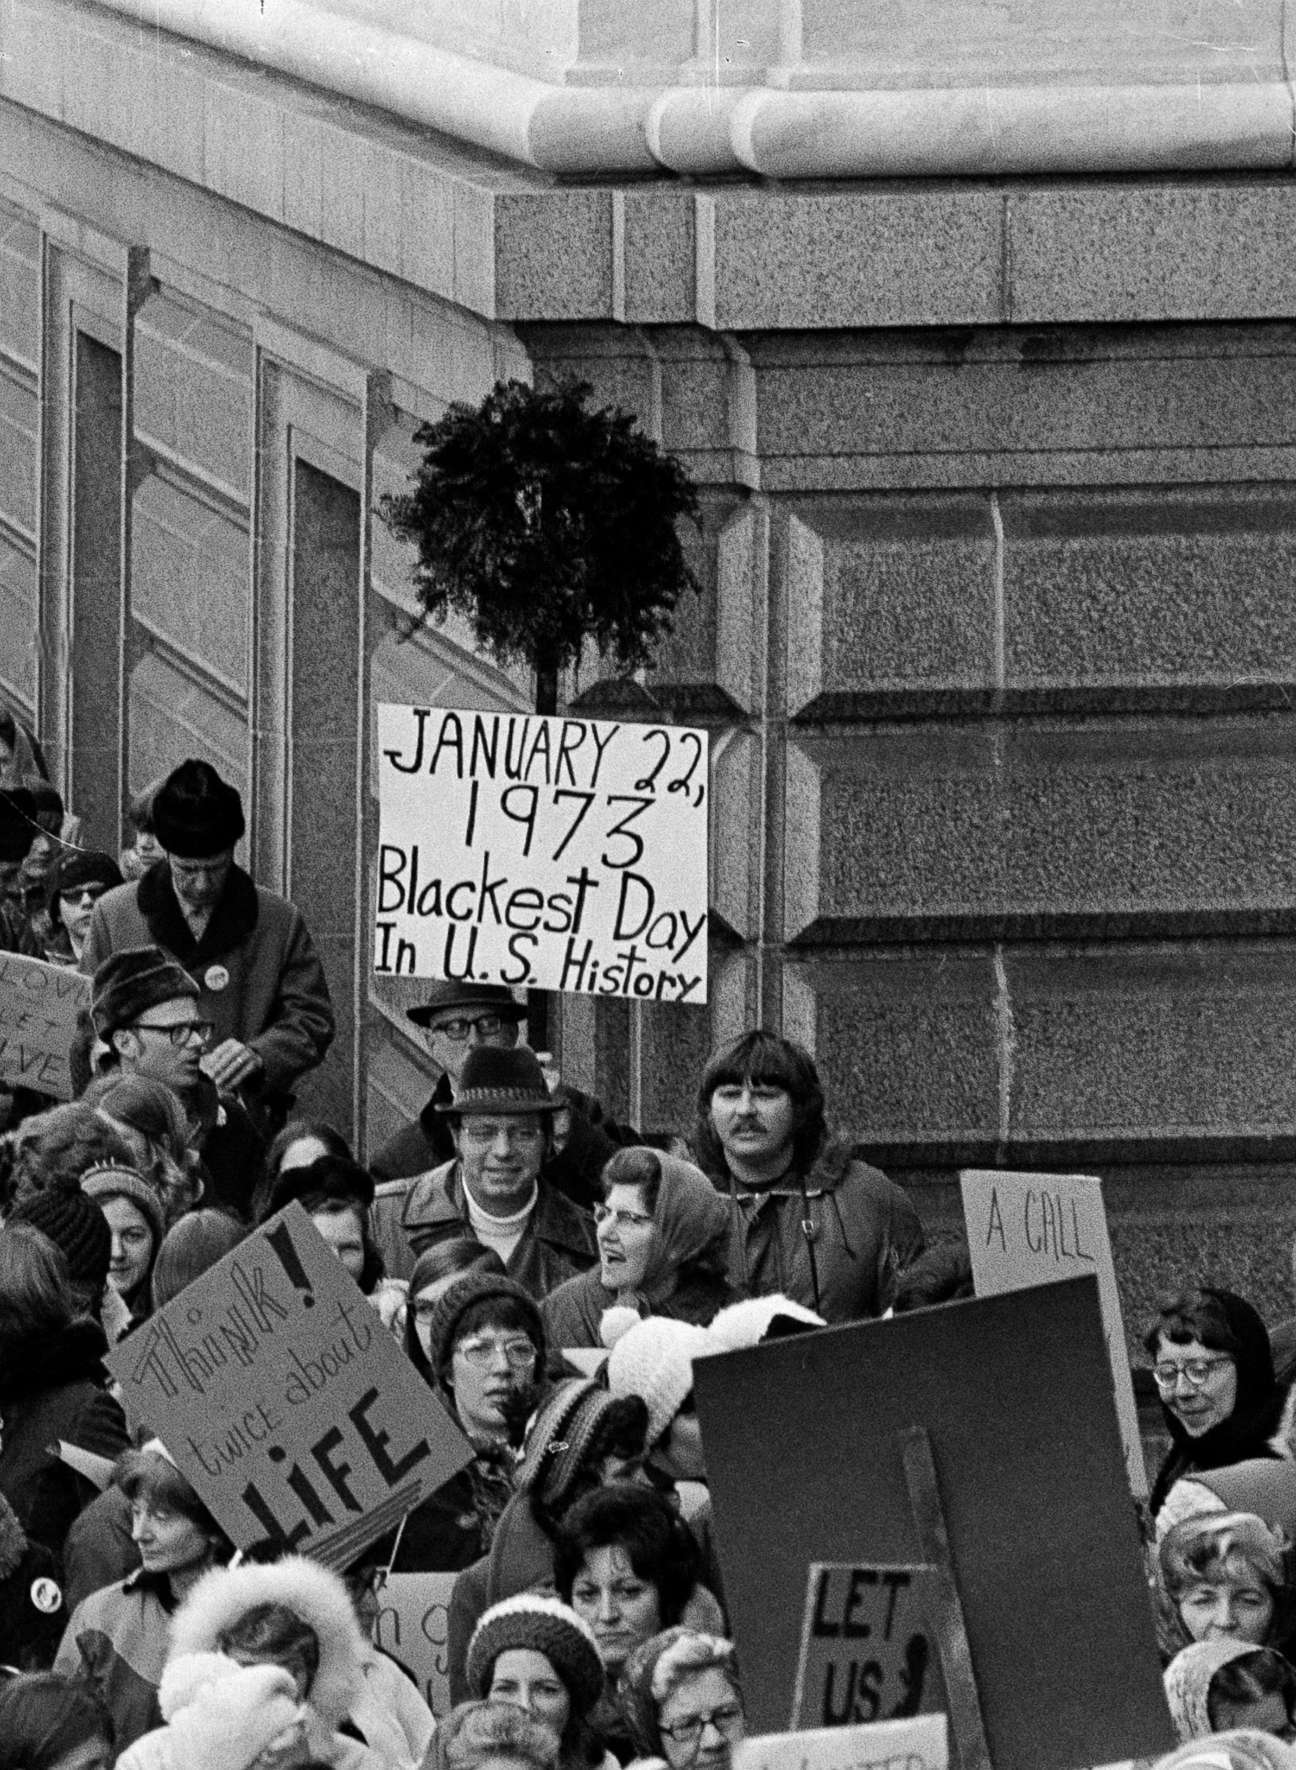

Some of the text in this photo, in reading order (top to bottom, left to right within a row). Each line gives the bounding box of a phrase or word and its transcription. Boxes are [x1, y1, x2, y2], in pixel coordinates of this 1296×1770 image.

[383, 708, 705, 808] JANUARY 22,
[465, 780, 656, 869] 1973
[377, 844, 707, 964] Blackest Day
[375, 923, 416, 974] In
[559, 938, 702, 1000] History
[986, 1186, 1096, 1263] A CALL
[284, 1301, 373, 1406] about
[812, 1568, 912, 1642] LET
[822, 1659, 886, 1727] US
